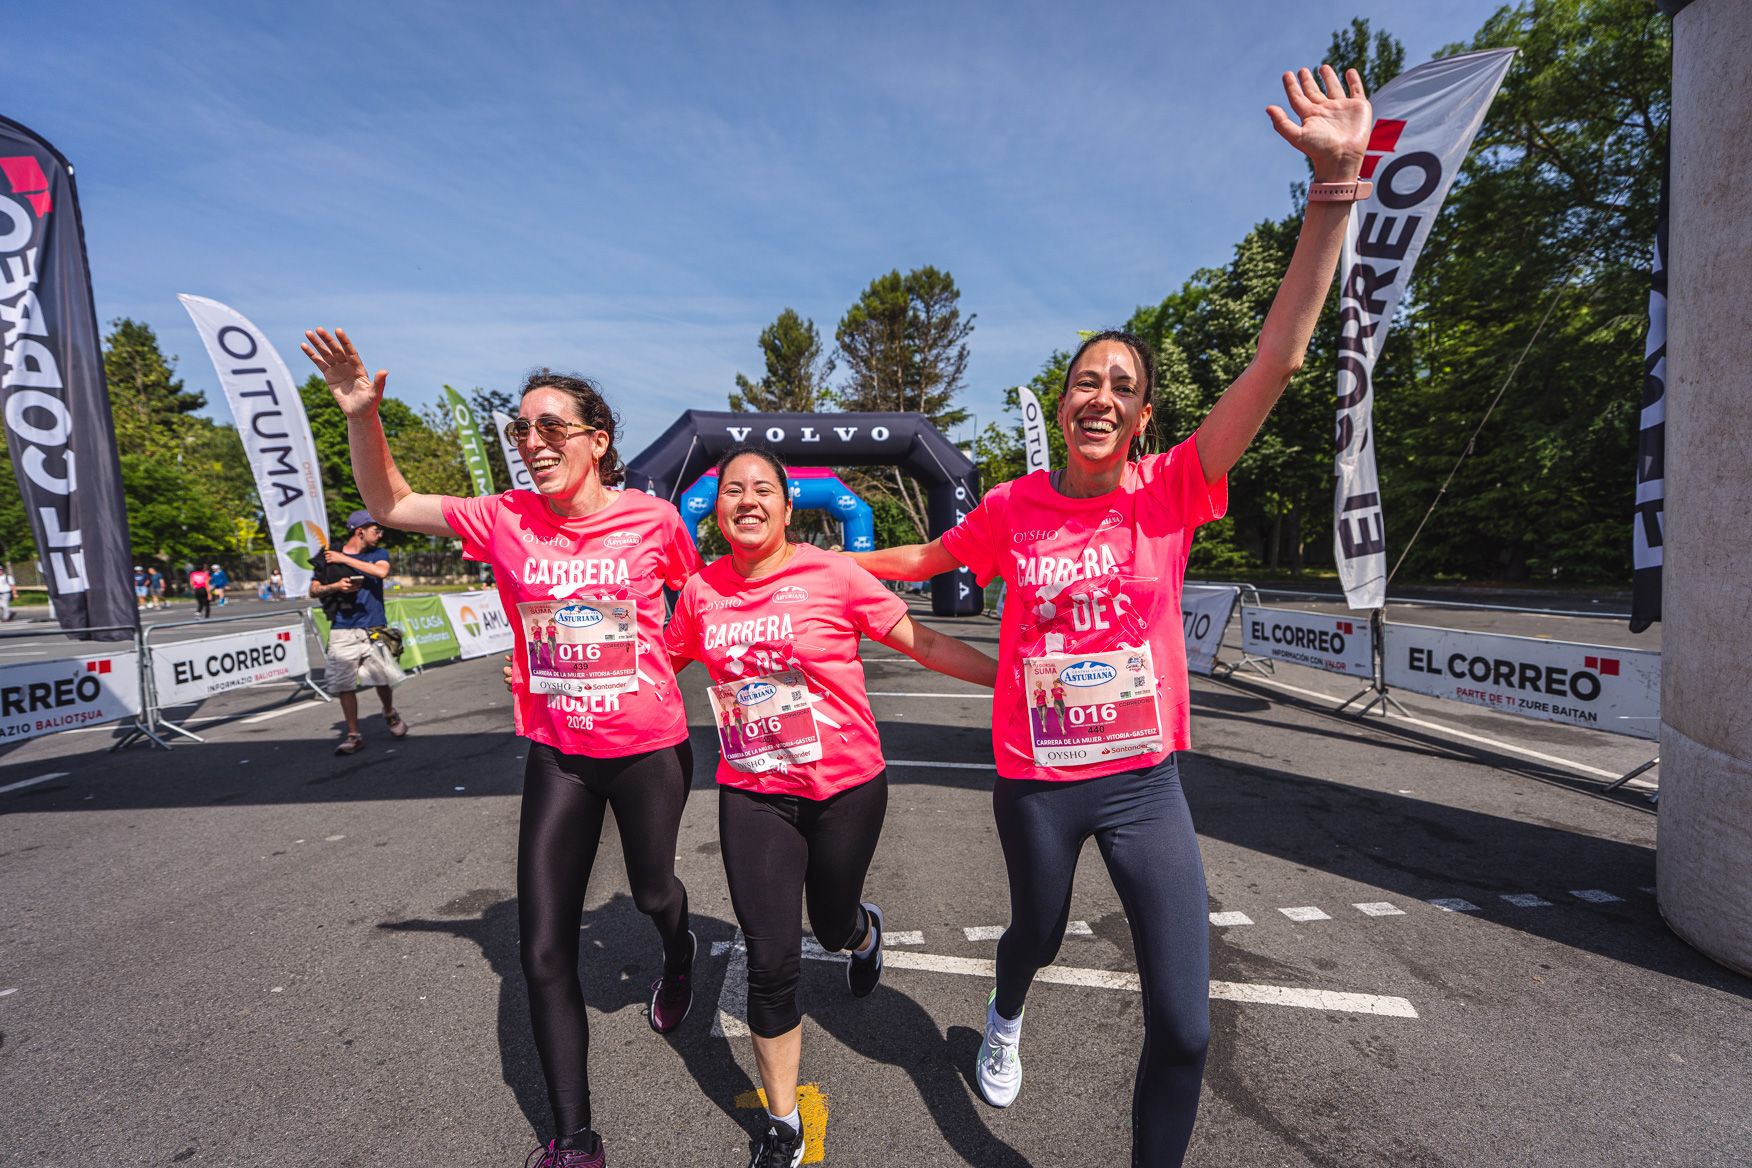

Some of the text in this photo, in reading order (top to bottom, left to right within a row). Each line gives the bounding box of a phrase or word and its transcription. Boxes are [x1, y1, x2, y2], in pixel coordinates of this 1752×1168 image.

[726, 426, 891, 443] VOLVO
[522, 533, 570, 549] OYSHO
[523, 557, 630, 586] CARRERA
[1017, 544, 1119, 588] CARRERA
[557, 613, 600, 623] ASTURIANA
[1072, 590, 1111, 632] DE
[704, 612, 795, 650] CARRERA
[1252, 621, 1345, 654] EL CORREO
[559, 643, 602, 661] 016
[1272, 648, 1309, 662] INFORMACIÓN
[1310, 656, 1324, 665] CON
[173, 643, 286, 685] EL CORREO
[572, 662, 589, 671] 439
[1034, 667, 1057, 675] SUMA
[532, 669, 552, 677] CARRERA
[568, 670, 586, 678] MUJER
[1065, 670, 1113, 682] ASTURIANA
[1408, 647, 1601, 701] EL CORREO
[207, 676, 253, 693] INFORMAZIO
[539, 681, 571, 691] OYSHO
[592, 681, 627, 691] Santander
[1456, 687, 1597, 722] PARTE DE TI ZURE BAITAN
[35, 709, 103, 731] BALIOTSUA
[1069, 703, 1118, 724] 016
[566, 715, 594, 730] 2026
[745, 716, 782, 738] 016
[1087, 725, 1105, 734] 440
[1036, 737, 1063, 746] CARRERA
[1064, 736, 1072, 744] DE
[1073, 735, 1080, 744] LA
[1081, 734, 1102, 743] MUJER
[1111, 743, 1149, 754] Santander
[1047, 749, 1087, 760] OYSHO
